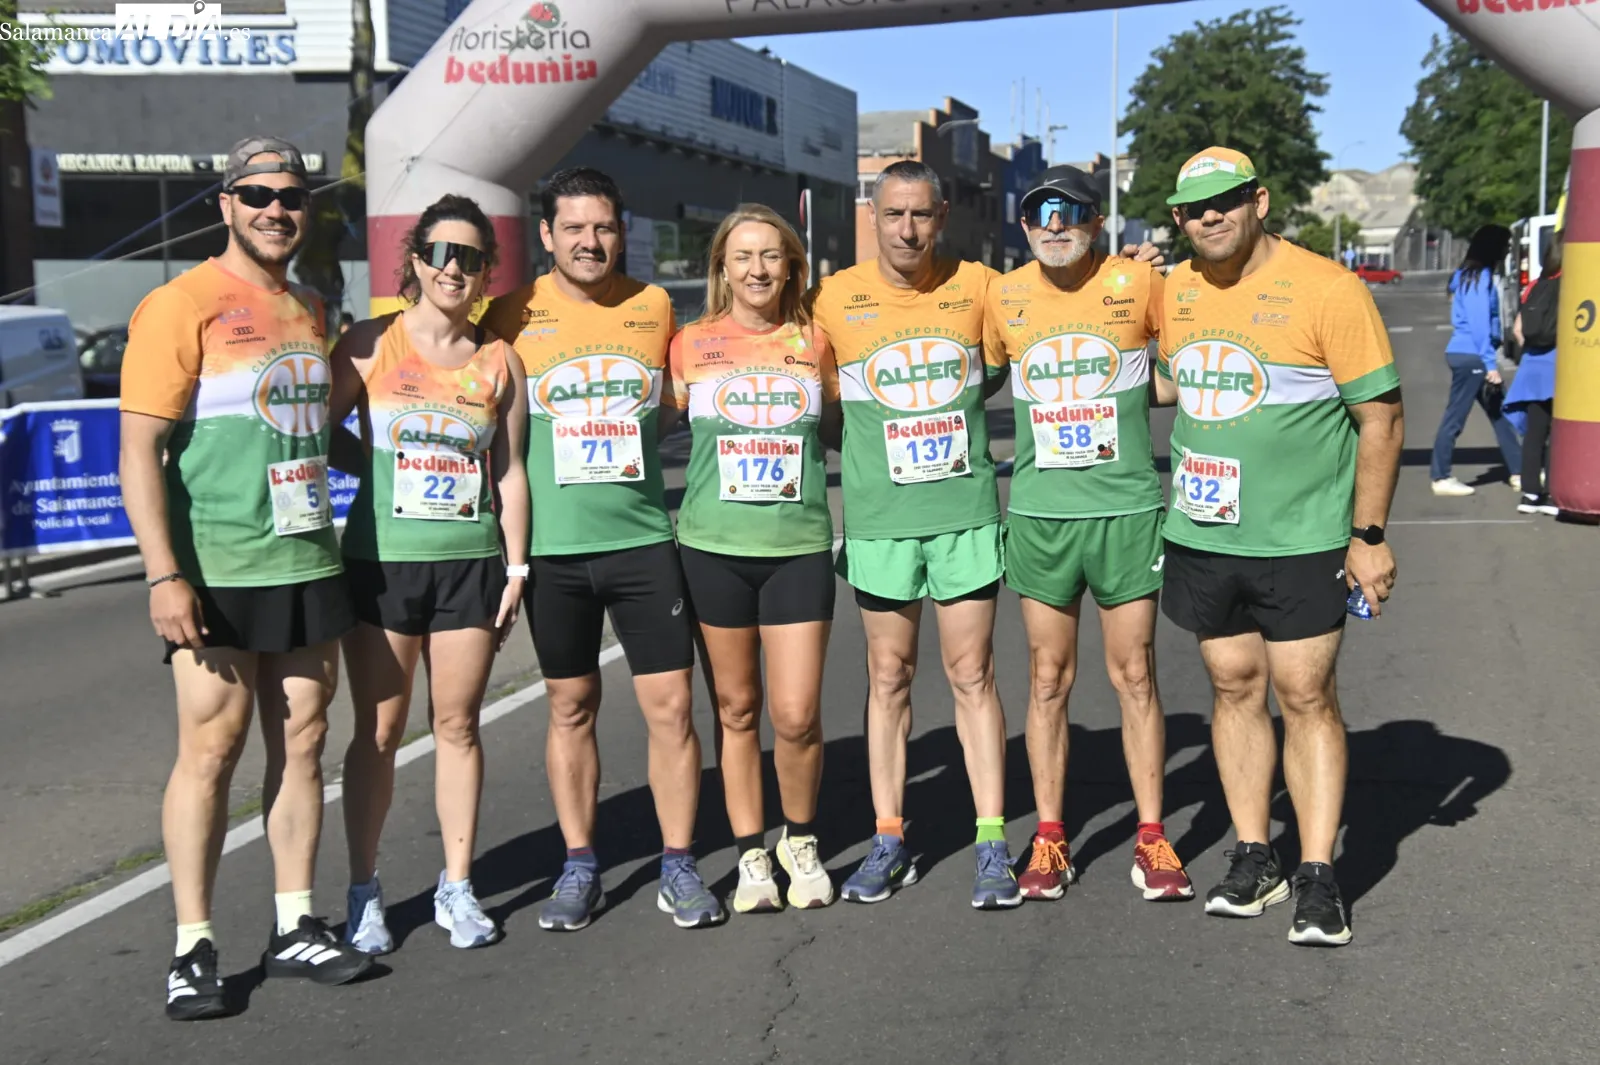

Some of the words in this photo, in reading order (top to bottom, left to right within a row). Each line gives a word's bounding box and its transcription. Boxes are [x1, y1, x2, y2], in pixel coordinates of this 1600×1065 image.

[58, 33, 298, 66] OMOVILES
[444, 53, 598, 85] bedunia
[857, 335, 889, 360] CLUB
[895, 326, 971, 346] DEPORTIVO
[1017, 330, 1043, 354] CLUB
[1049, 322, 1121, 344] DEPORTIVO
[1201, 328, 1269, 360] DEPORTIVO
[532, 351, 567, 376] CLUB
[574, 343, 654, 367] DEPORTIVO
[1026, 355, 1111, 381] ALCER
[715, 367, 741, 384] CLUB
[746, 365, 807, 384] DEPORTIVO
[874, 359, 962, 388] ALCER
[1176, 368, 1255, 397] ALCER
[265, 382, 331, 407] ALCER
[546, 378, 644, 403] ALCER
[722, 391, 802, 410] ALCER
[423, 401, 484, 433] DEPORTIVO
[1031, 403, 1115, 424] bedunia
[397, 428, 471, 451] ALCER
[555, 420, 638, 438] bedunia
[1058, 424, 1092, 449] 58
[581, 439, 613, 464] 71
[906, 435, 953, 464] 137
[397, 454, 478, 474] bedunia
[737, 457, 784, 482] 176
[306, 482, 320, 509] 5
[423, 474, 457, 501] 22
[1180, 473, 1221, 503] 132
